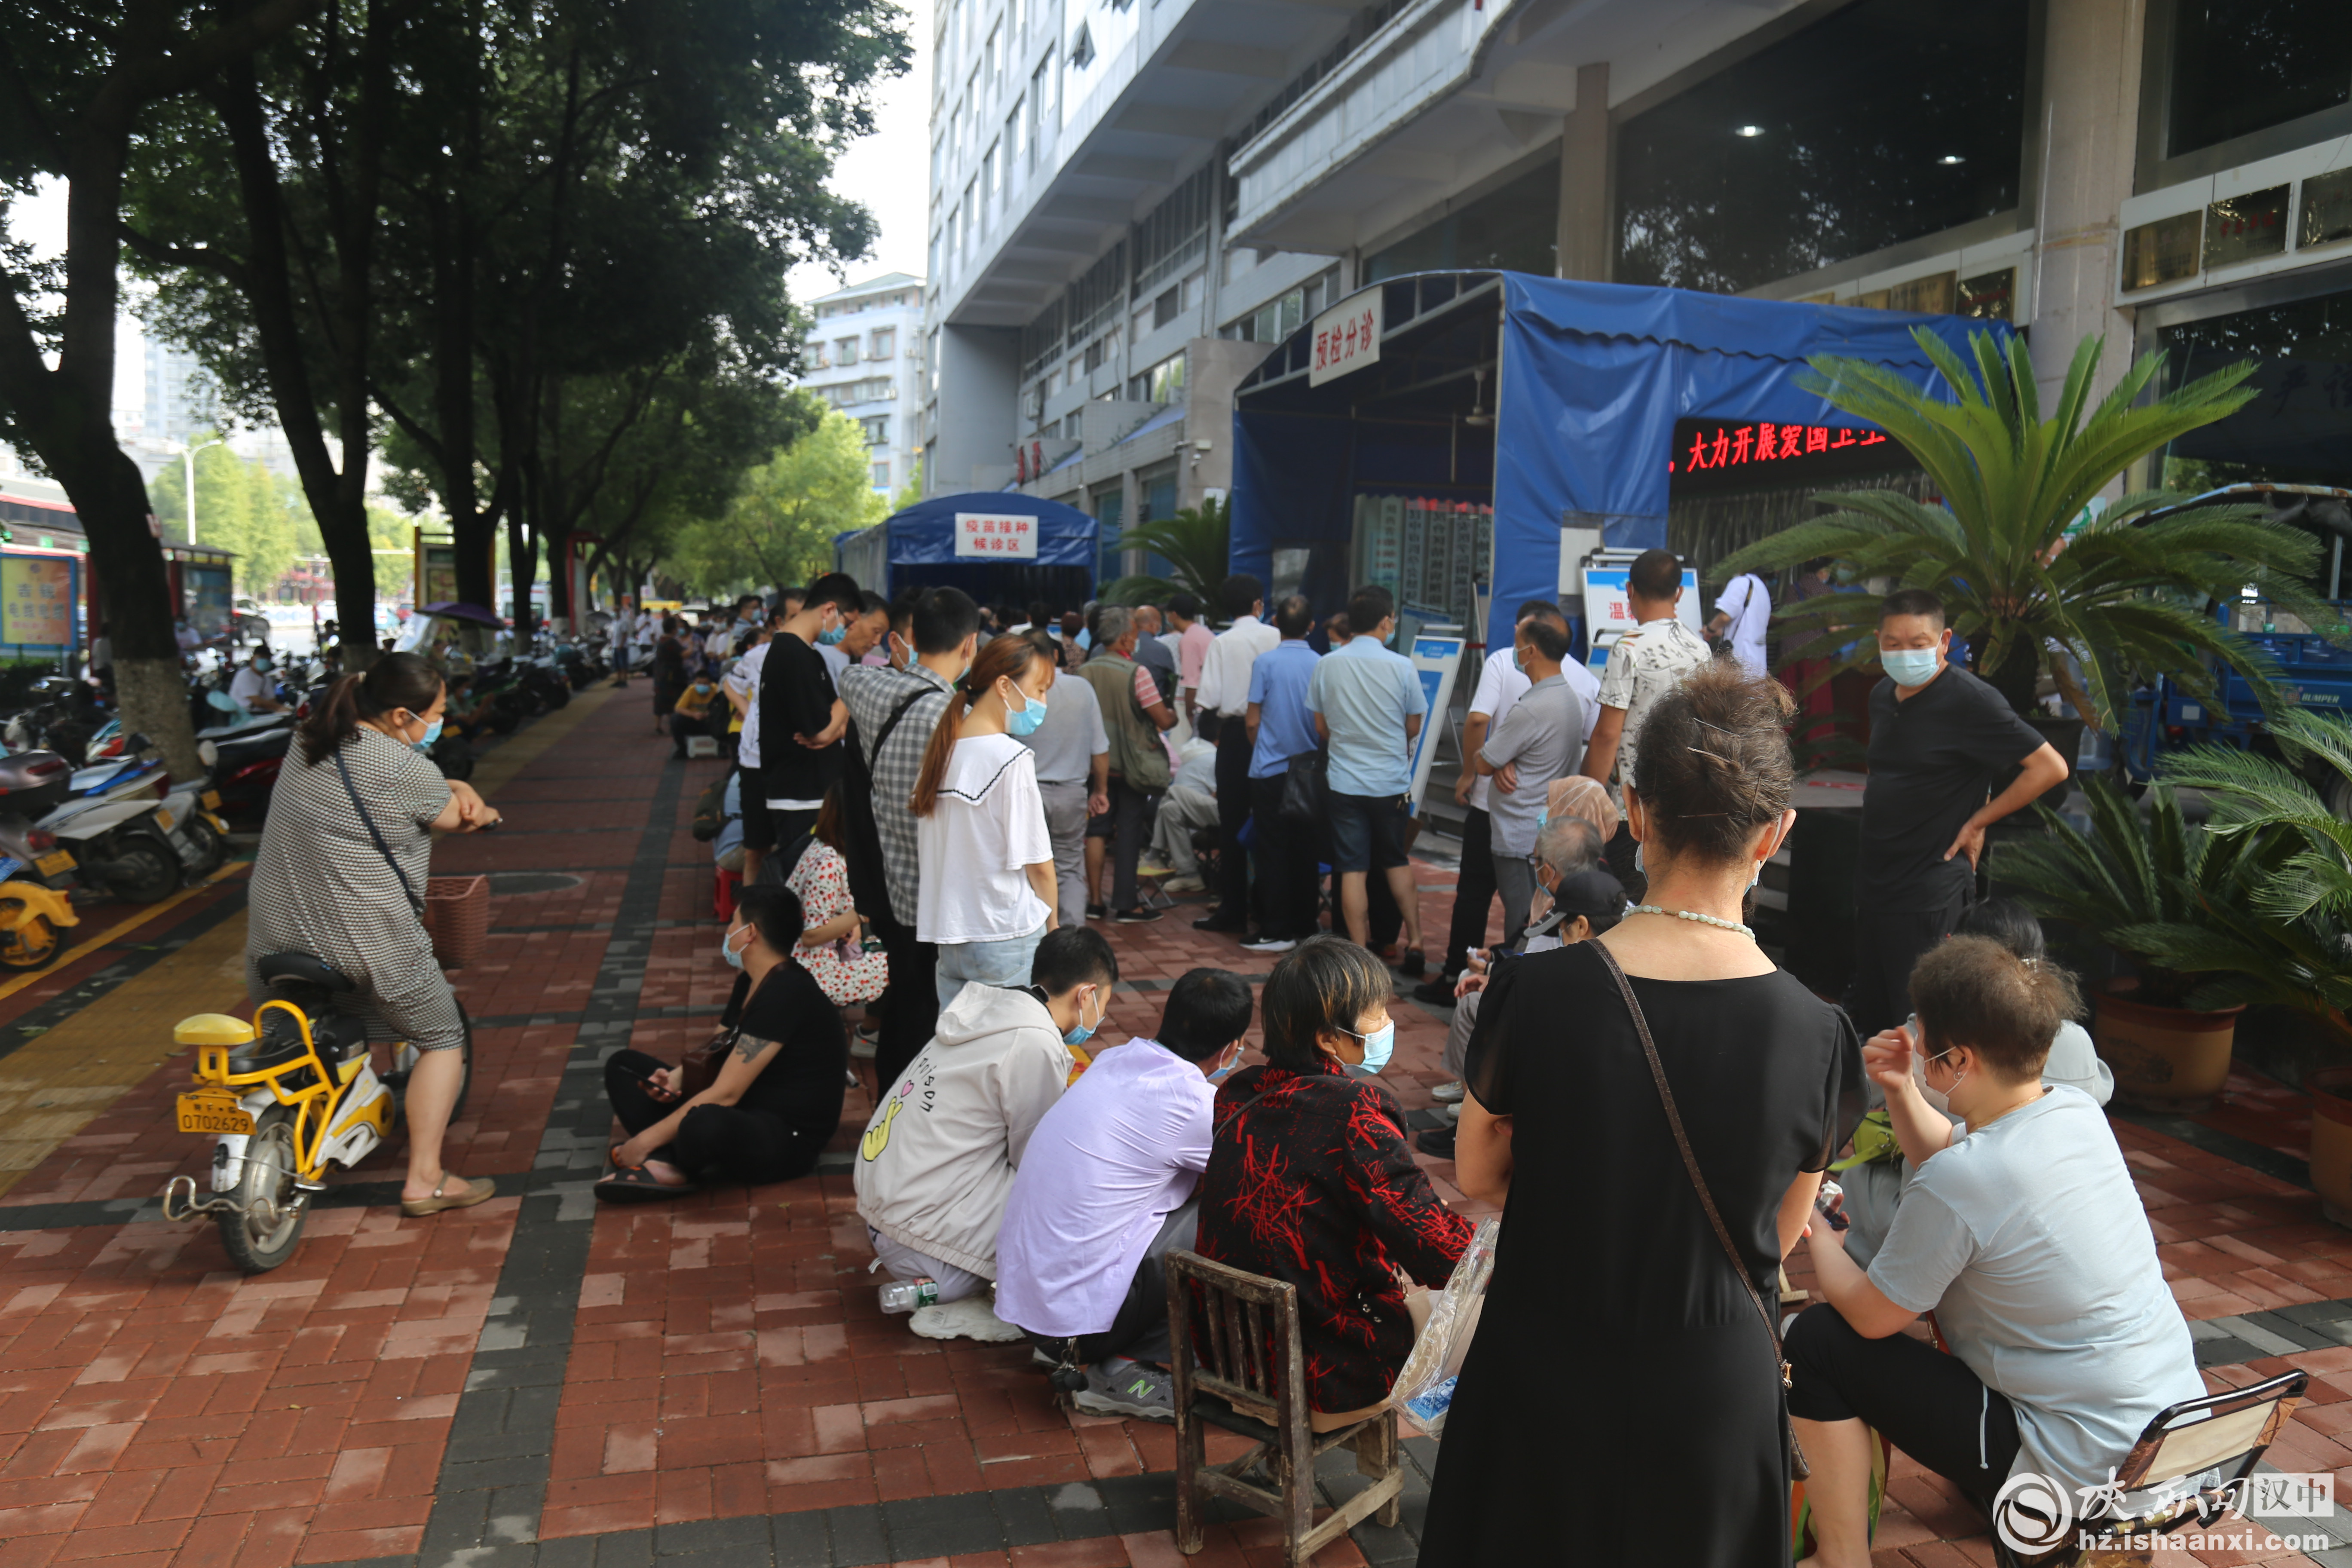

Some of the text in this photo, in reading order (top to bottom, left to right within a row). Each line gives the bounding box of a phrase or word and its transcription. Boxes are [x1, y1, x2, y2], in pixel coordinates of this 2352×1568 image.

[1315, 309, 1374, 371] 预检分诊
[965, 520, 1029, 535] 疫苗接种
[974, 538, 1020, 551] 候诊区
[183, 1115, 248, 1131] 0702629
[1127, 1379, 1156, 1400] N
